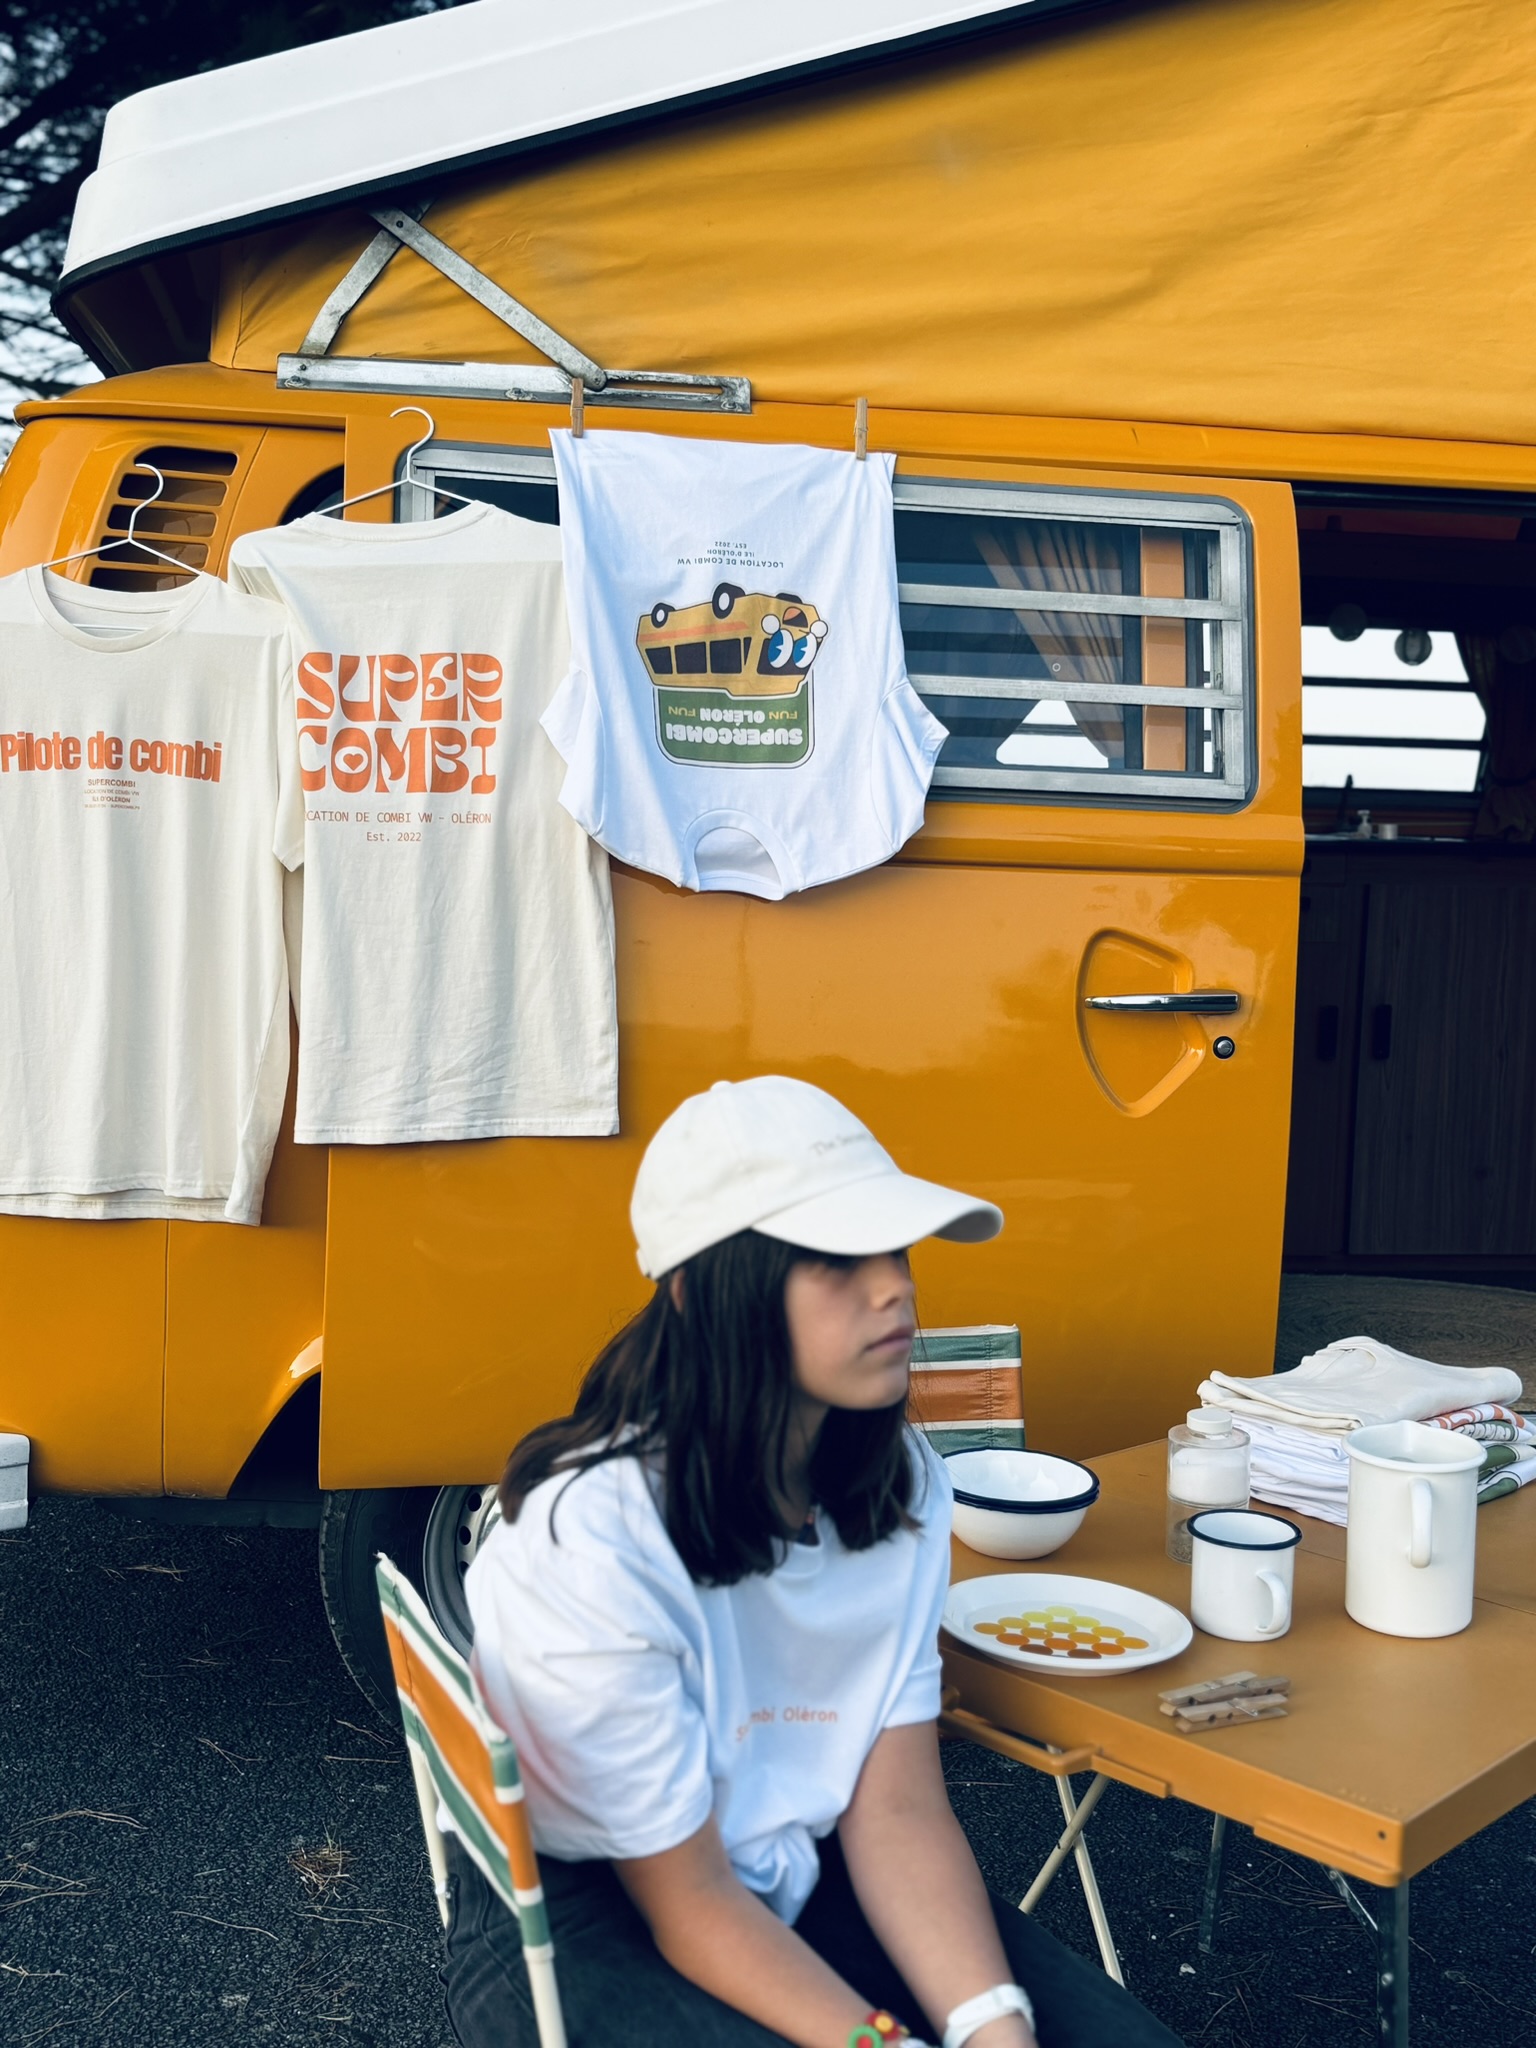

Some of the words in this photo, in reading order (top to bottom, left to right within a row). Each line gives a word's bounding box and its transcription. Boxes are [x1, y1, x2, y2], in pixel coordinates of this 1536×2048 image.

[694, 557, 723, 565] COMBI
[725, 558, 737, 566] DE
[739, 559, 784, 569] LOCATION
[297, 651, 504, 722] SUPER
[668, 706, 696, 718] FUN
[700, 708, 765, 726] OLÉRON
[768, 710, 798, 720] FUN
[665, 723, 803, 746] SUPERCOMBI
[0, 731, 81, 772] Pilote
[87, 731, 123, 770] de
[130, 740, 222, 783] combi
[298, 725, 497, 795] COMBI
[87, 778, 136, 788] SUPERCOMBI
[304, 810, 349, 822] CATION
[356, 812, 370, 823] DE
[376, 812, 411, 823] COMBI
[418, 812, 433, 823] VW
[451, 810, 492, 824] OLÉRON
[366, 832, 390, 842] Est.
[397, 832, 422, 842] 2022
[783, 1706, 838, 1723] Oléron
